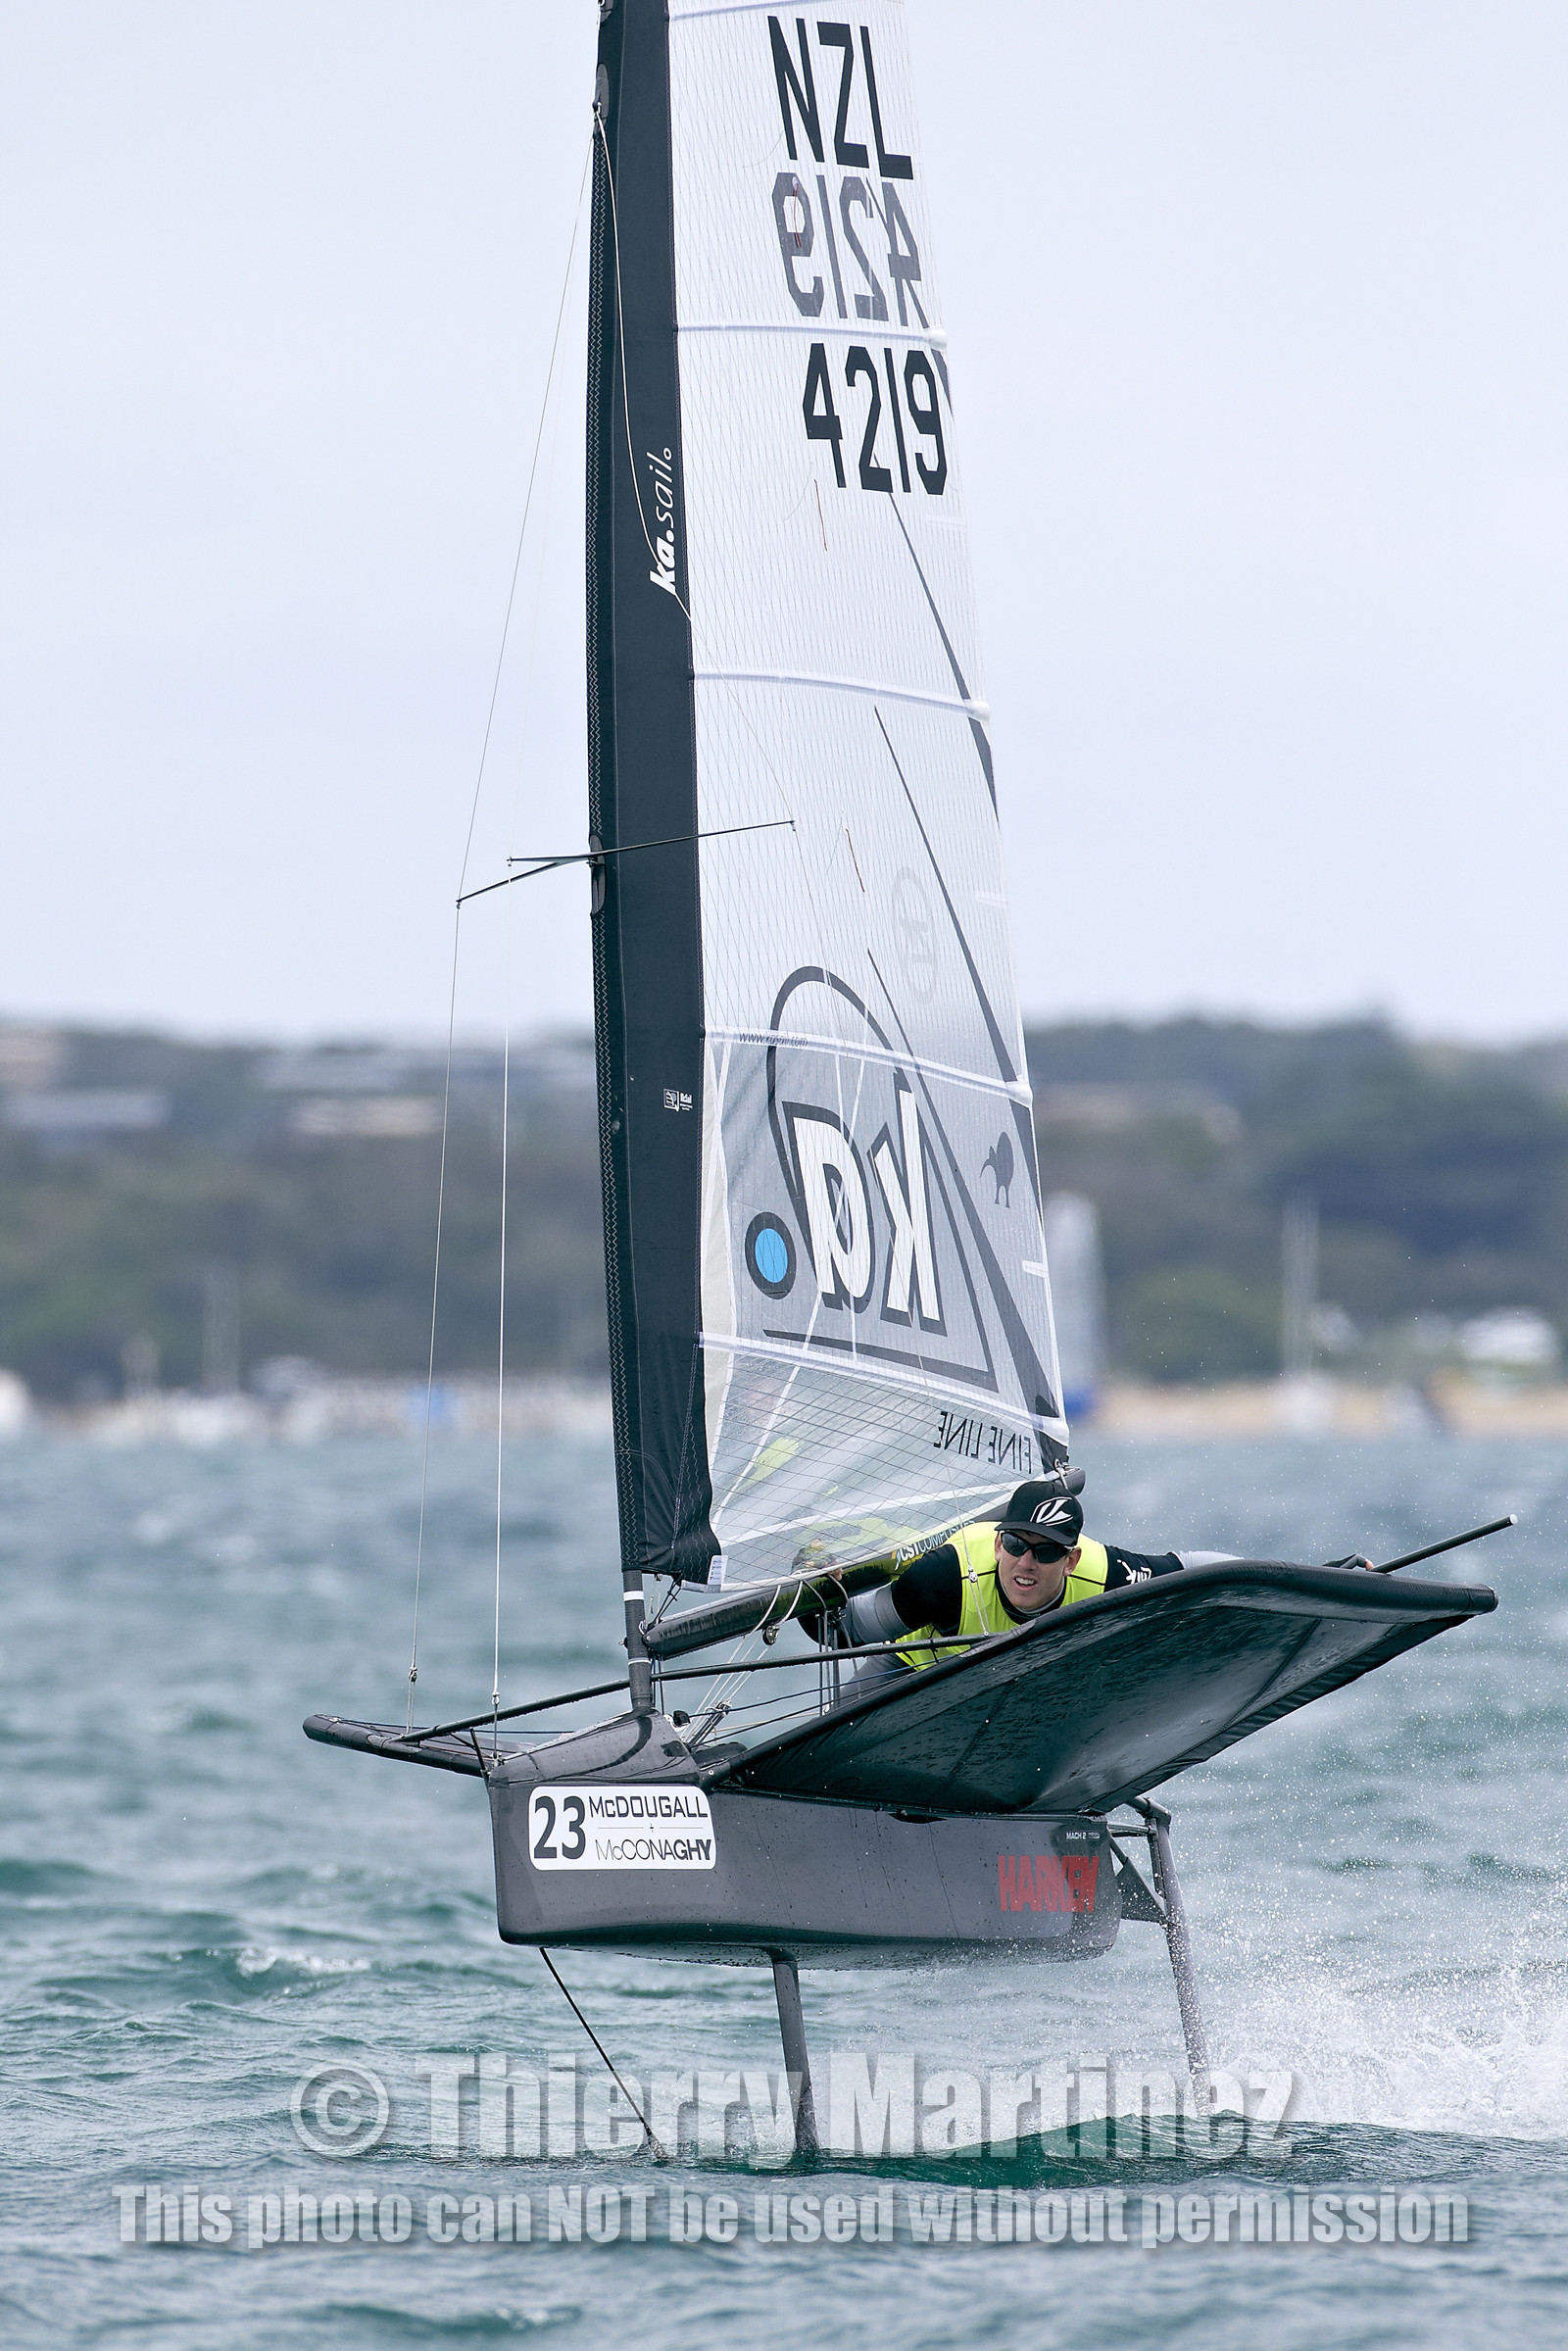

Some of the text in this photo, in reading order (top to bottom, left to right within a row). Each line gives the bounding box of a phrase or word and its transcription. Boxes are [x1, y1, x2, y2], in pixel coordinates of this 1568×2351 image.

[767, 16, 913, 180] NZL
[803, 343, 948, 496] 4219
[533, 1795, 586, 1860] 23
[589, 1795, 709, 1818] McDOUGALL
[595, 1838, 711, 1860] McCONAGHY
[1065, 1832, 1082, 1840] MACH
[998, 1855, 1100, 1913] HARKEN
